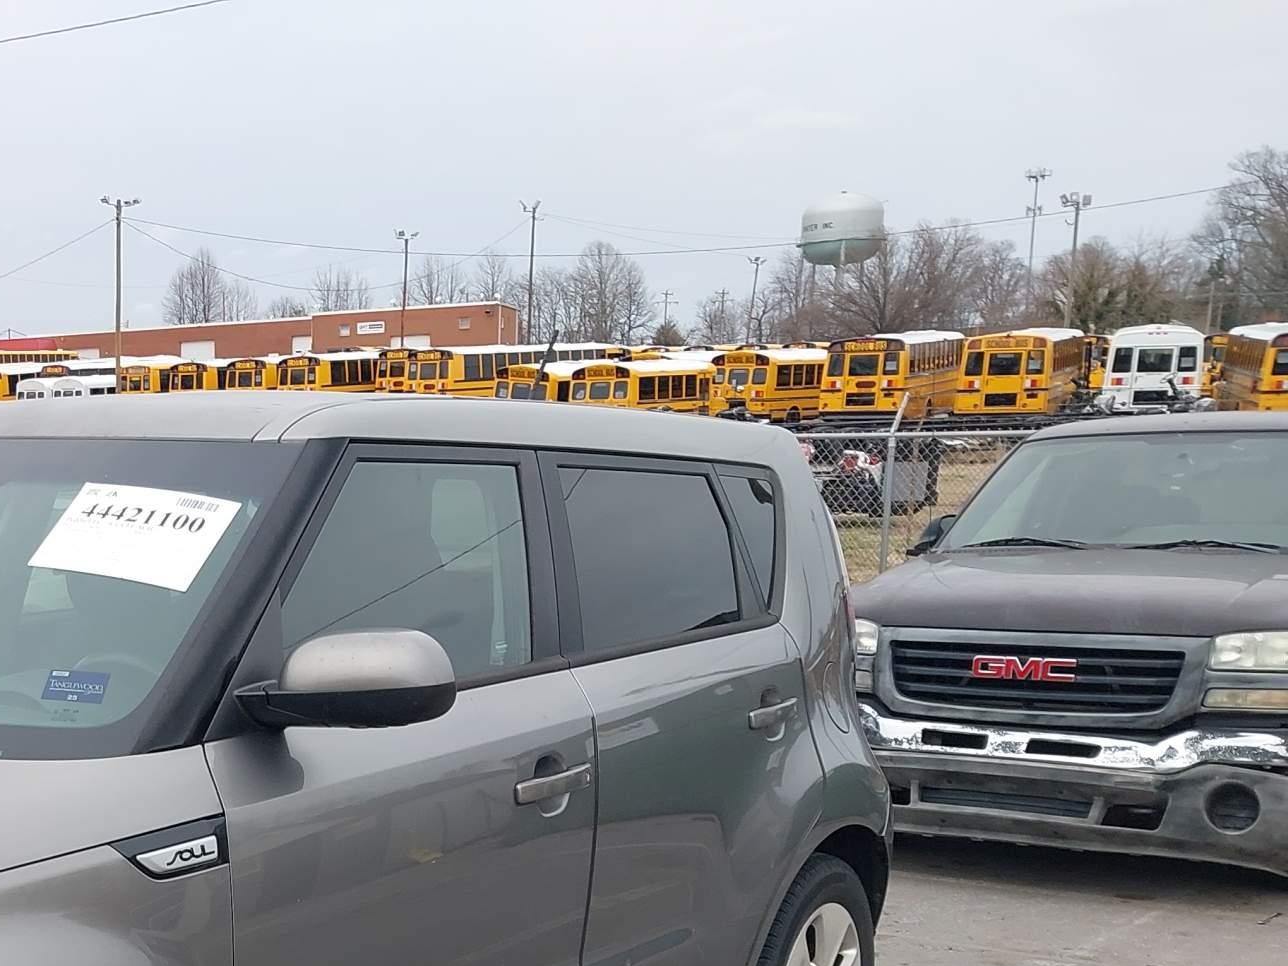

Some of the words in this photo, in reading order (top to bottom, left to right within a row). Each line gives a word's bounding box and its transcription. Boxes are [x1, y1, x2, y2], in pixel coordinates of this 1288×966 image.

[845, 342, 870, 351] SCHOOL
[872, 341, 887, 351] BUS
[81, 503, 207, 534] 44421100
[972, 654, 1078, 682] GMC
[166, 844, 216, 867] SOUL
